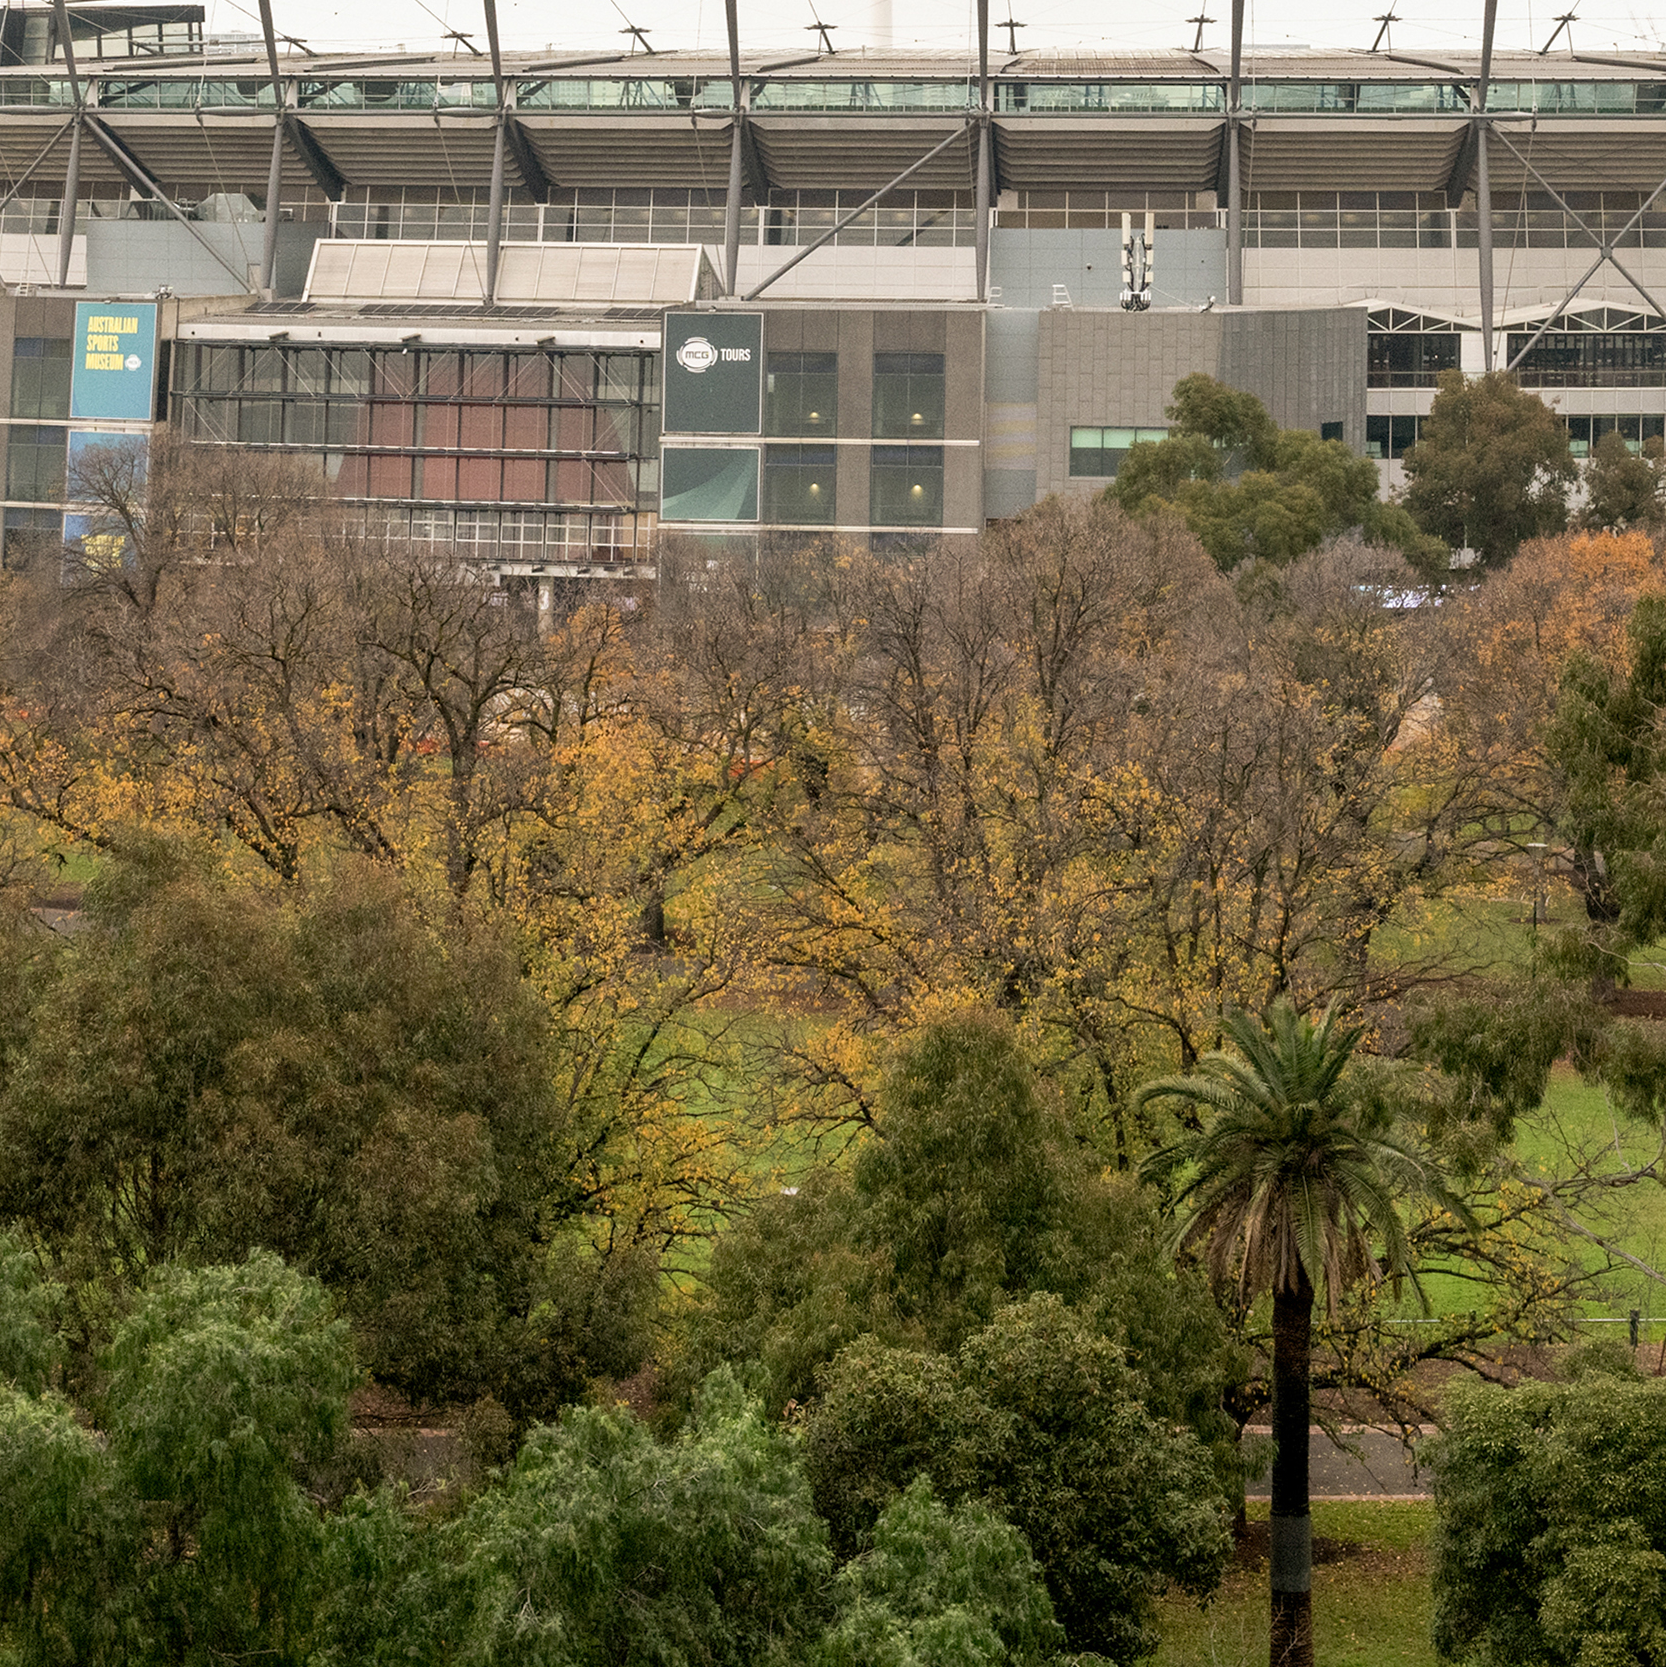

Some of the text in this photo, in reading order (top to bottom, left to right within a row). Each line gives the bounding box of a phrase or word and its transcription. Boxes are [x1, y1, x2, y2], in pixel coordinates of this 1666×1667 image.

[87, 316, 138, 334] AUSTRALIAN
[86, 334, 119, 352] SPORTS
[85, 352, 124, 371] MUSEUM
[685, 348, 751, 361] MCG TOURS
